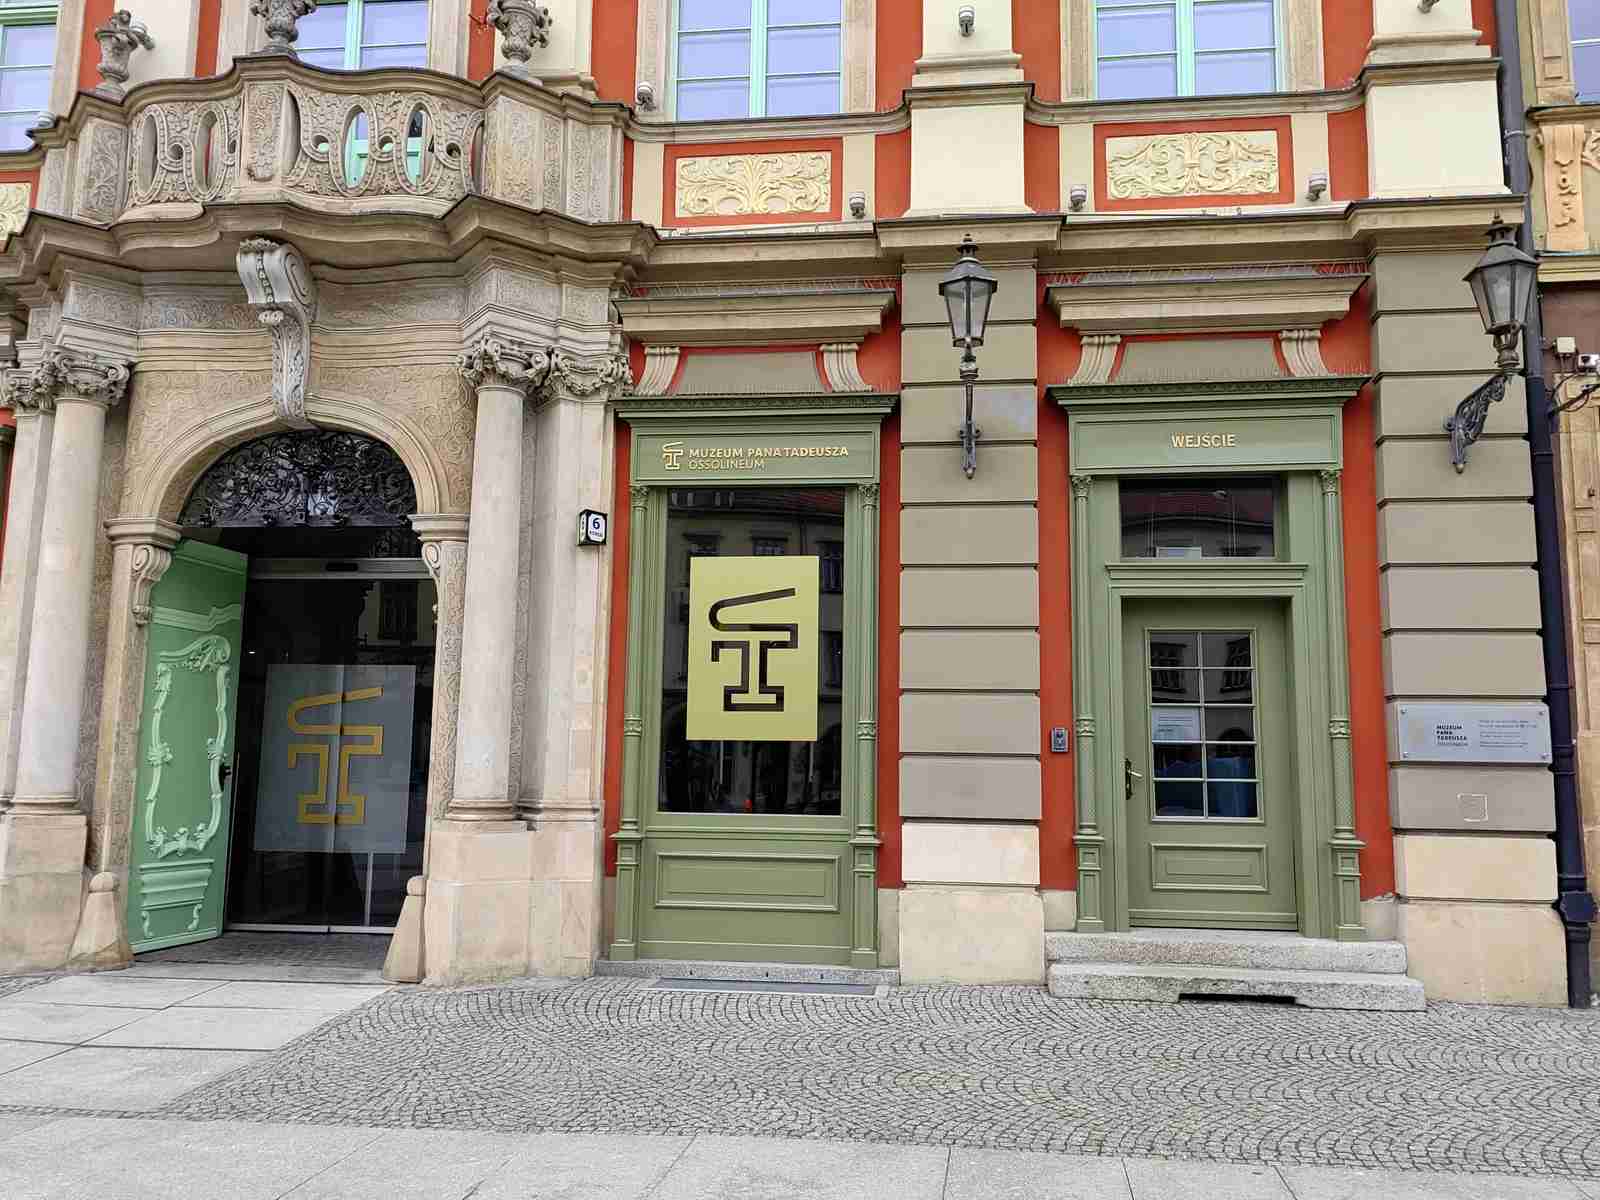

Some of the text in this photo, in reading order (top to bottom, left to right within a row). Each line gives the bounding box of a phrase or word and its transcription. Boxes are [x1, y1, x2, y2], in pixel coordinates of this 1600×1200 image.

[1171, 432, 1236, 448] WEJŚCIE
[689, 446, 849, 458] MUZEUM PANA TADEUSZA
[689, 458, 767, 470] OSSOLINEUM
[592, 517, 601, 530] 6
